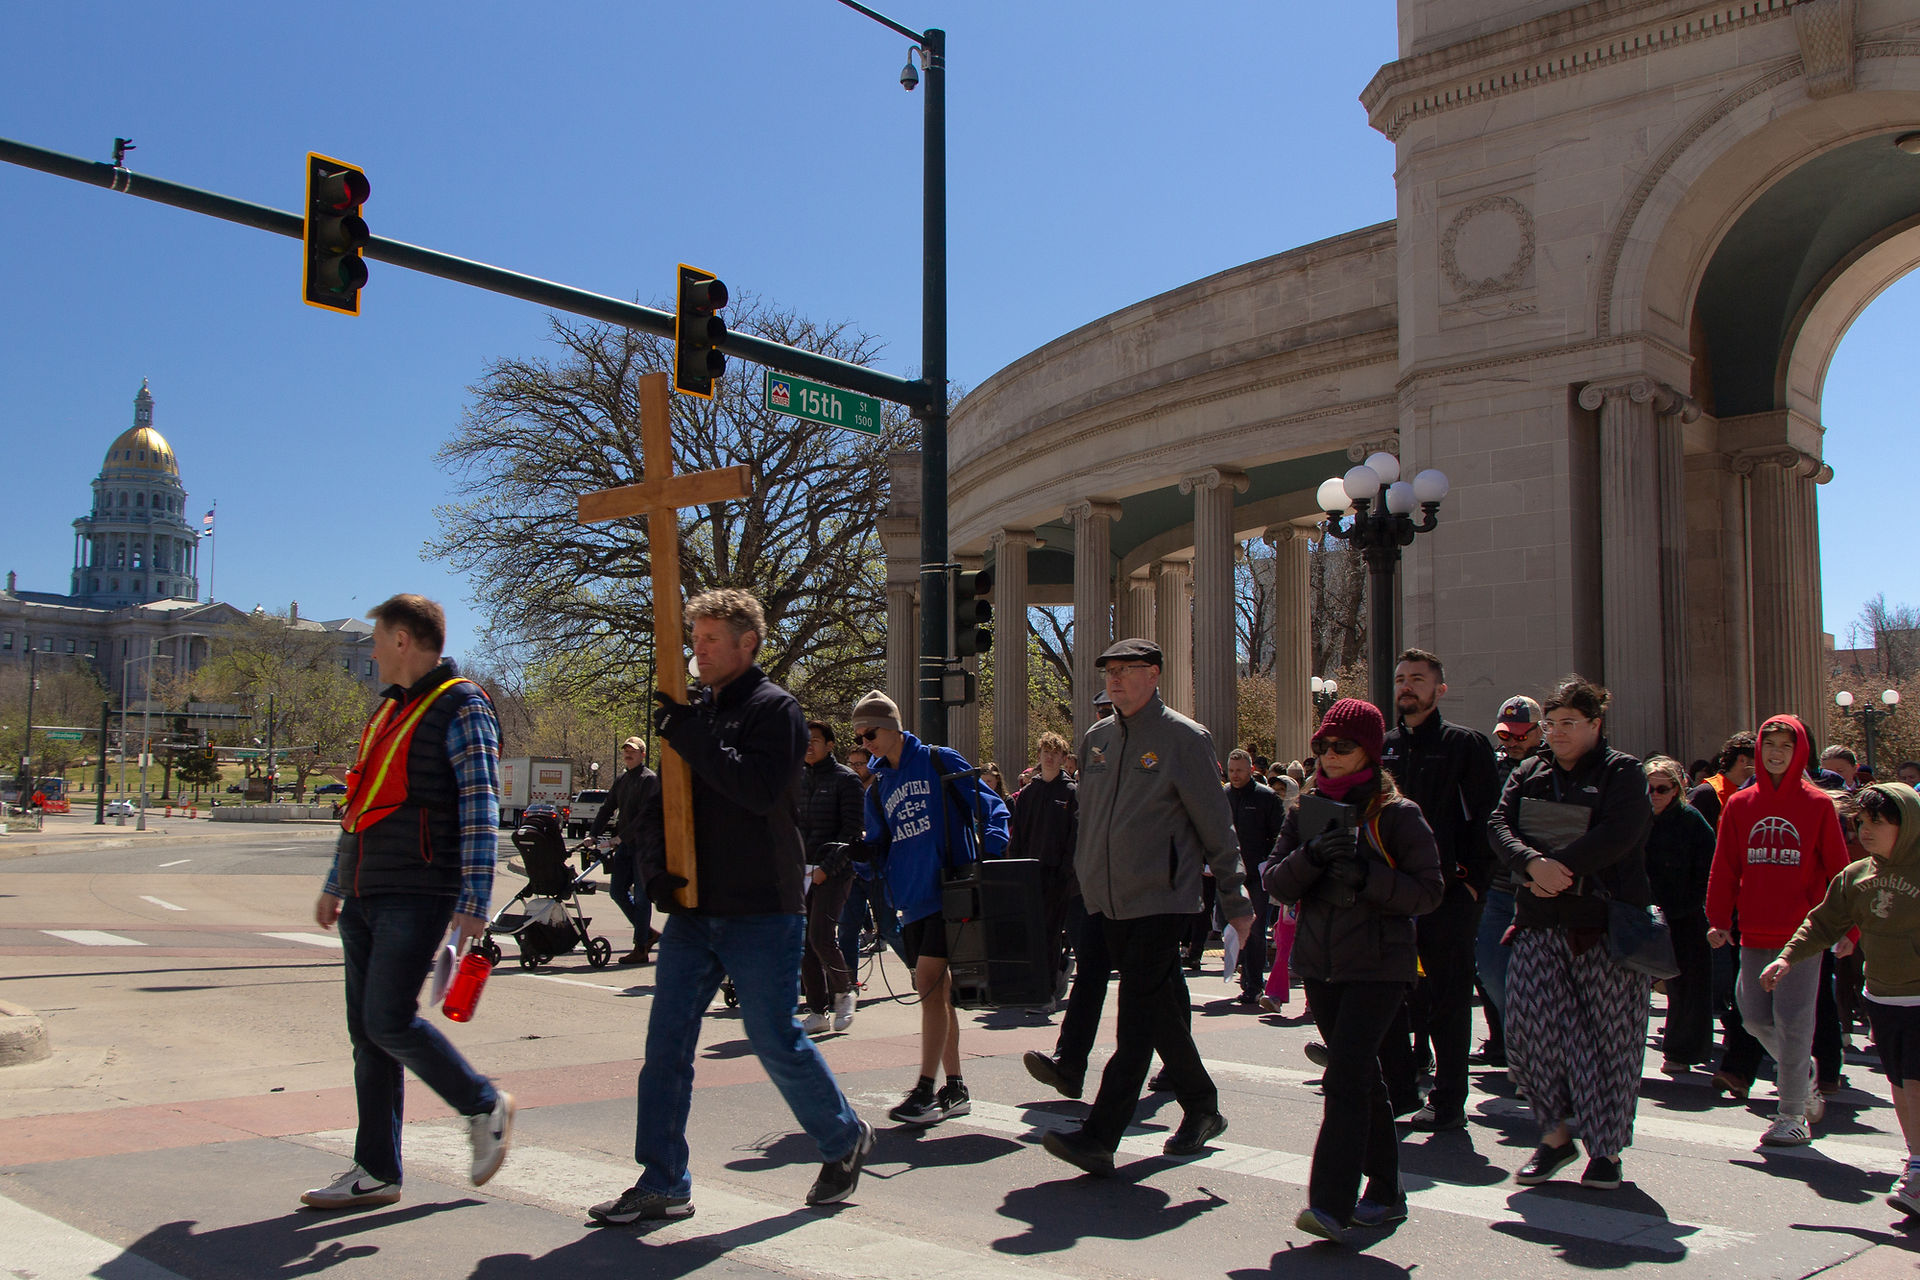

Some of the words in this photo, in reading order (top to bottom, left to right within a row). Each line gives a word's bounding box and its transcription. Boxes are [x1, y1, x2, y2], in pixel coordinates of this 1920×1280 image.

[800, 388, 842, 420] 15th
[860, 402, 868, 412] St
[855, 415, 873, 427] 1500
